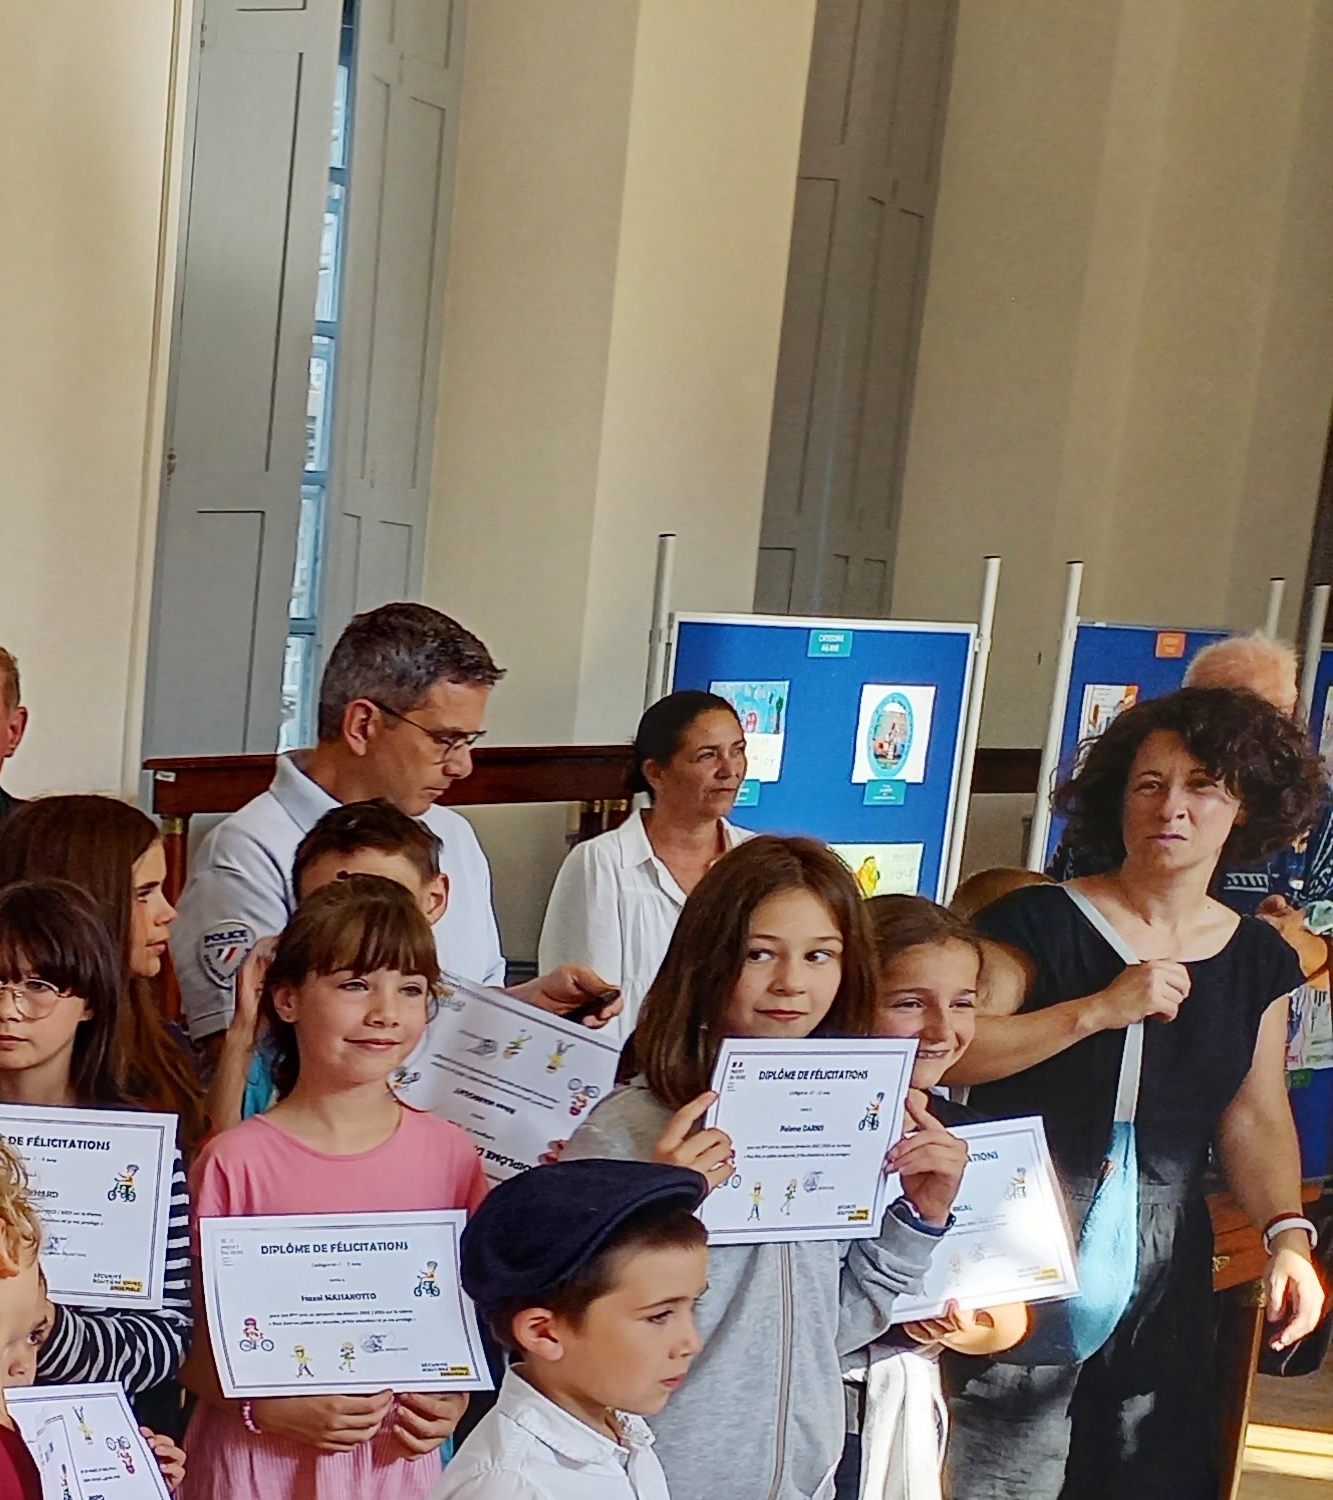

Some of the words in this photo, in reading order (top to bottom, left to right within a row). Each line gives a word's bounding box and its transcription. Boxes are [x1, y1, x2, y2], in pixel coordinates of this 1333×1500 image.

[758, 1068, 796, 1080] DIPLÔME
[797, 1071, 808, 1080] DE
[810, 1068, 868, 1080] FÉLICITATIONS
[8, 1135, 24, 1146] DE
[26, 1134, 110, 1152] FÉLICITATIONS
[260, 1242, 310, 1255] DIPLÔME
[313, 1244, 328, 1253] DE
[330, 1240, 409, 1253] FÉLICITATIONS
